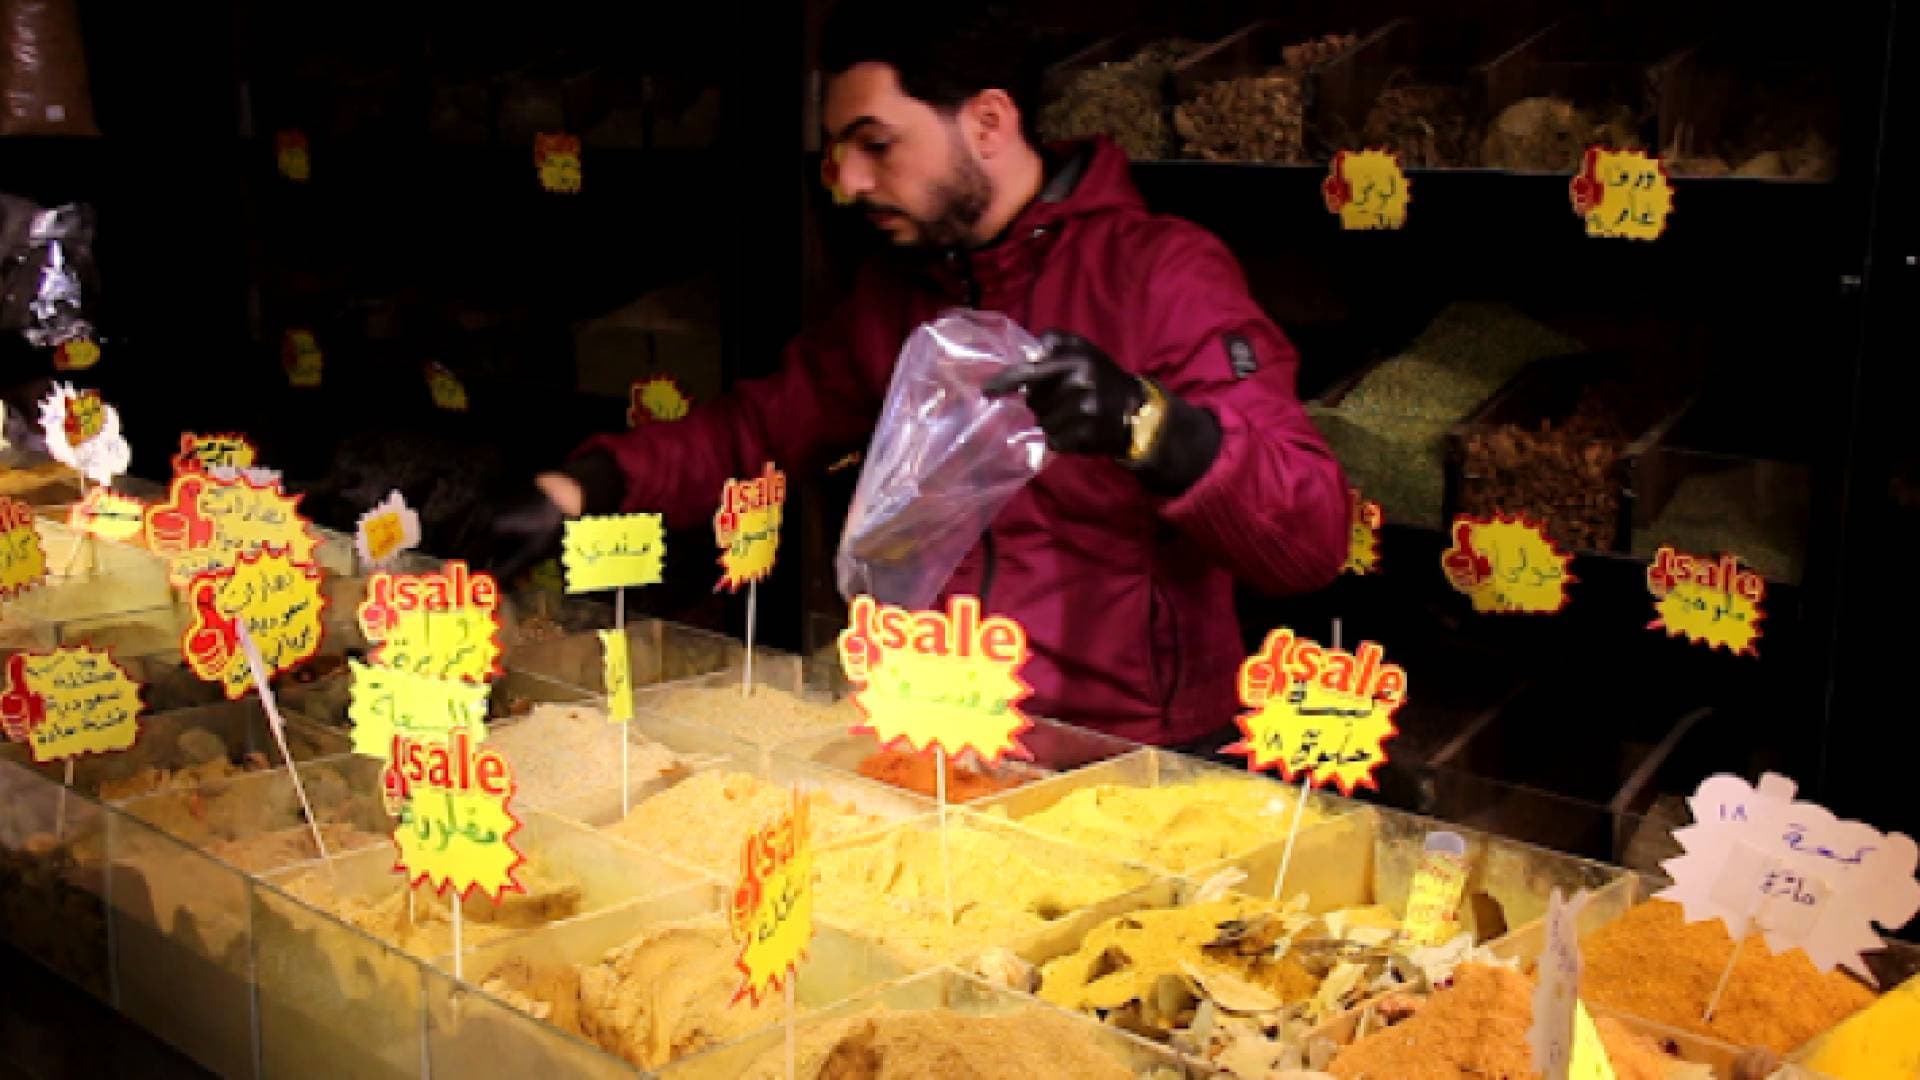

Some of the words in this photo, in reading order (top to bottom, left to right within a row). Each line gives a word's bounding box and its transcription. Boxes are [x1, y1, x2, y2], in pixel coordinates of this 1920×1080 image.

[738, 470, 785, 513] sale
[398, 566, 496, 610] sale
[1674, 554, 1763, 602] sale
[882, 602, 1018, 662] sale
[1291, 643, 1405, 704] sale
[408, 733, 506, 795] sale
